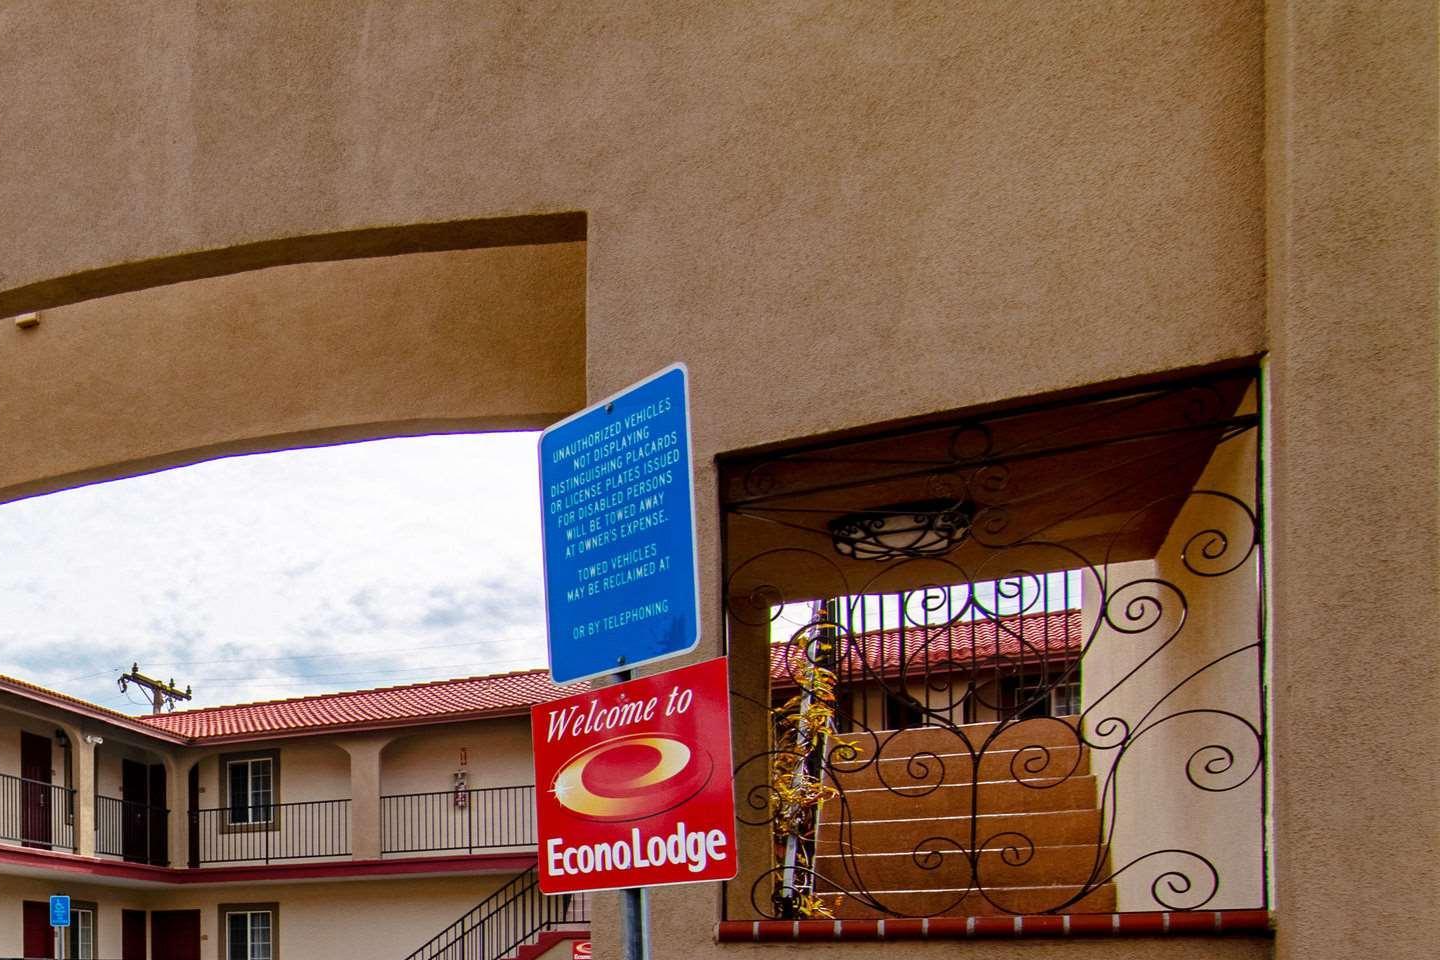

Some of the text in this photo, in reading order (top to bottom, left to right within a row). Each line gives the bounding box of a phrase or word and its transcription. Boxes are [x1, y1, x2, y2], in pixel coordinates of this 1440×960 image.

[553, 397, 671, 463] UNAUTHORIZED VEHICLES
[573, 425, 650, 471] NOT DISPLAYING
[550, 431, 678, 497] DISTINGUISHING PLACARDS
[550, 448, 680, 514] OR LICENSE PLATES ISSUED
[558, 470, 673, 528] FOR DISABLED PERSONS
[566, 491, 665, 540] WILL BE TOWED AWAY
[565, 509, 669, 559] AT OWNER'S EXPENSE.
[567, 556, 671, 603] MAY BE RECLAIMED AT
[578, 543, 657, 582] TOWED VEHICLES
[572, 599, 669, 640] OR BY TELEPHONING
[547, 686, 693, 743] Welcome to
[547, 822, 727, 877] EconoLodge
